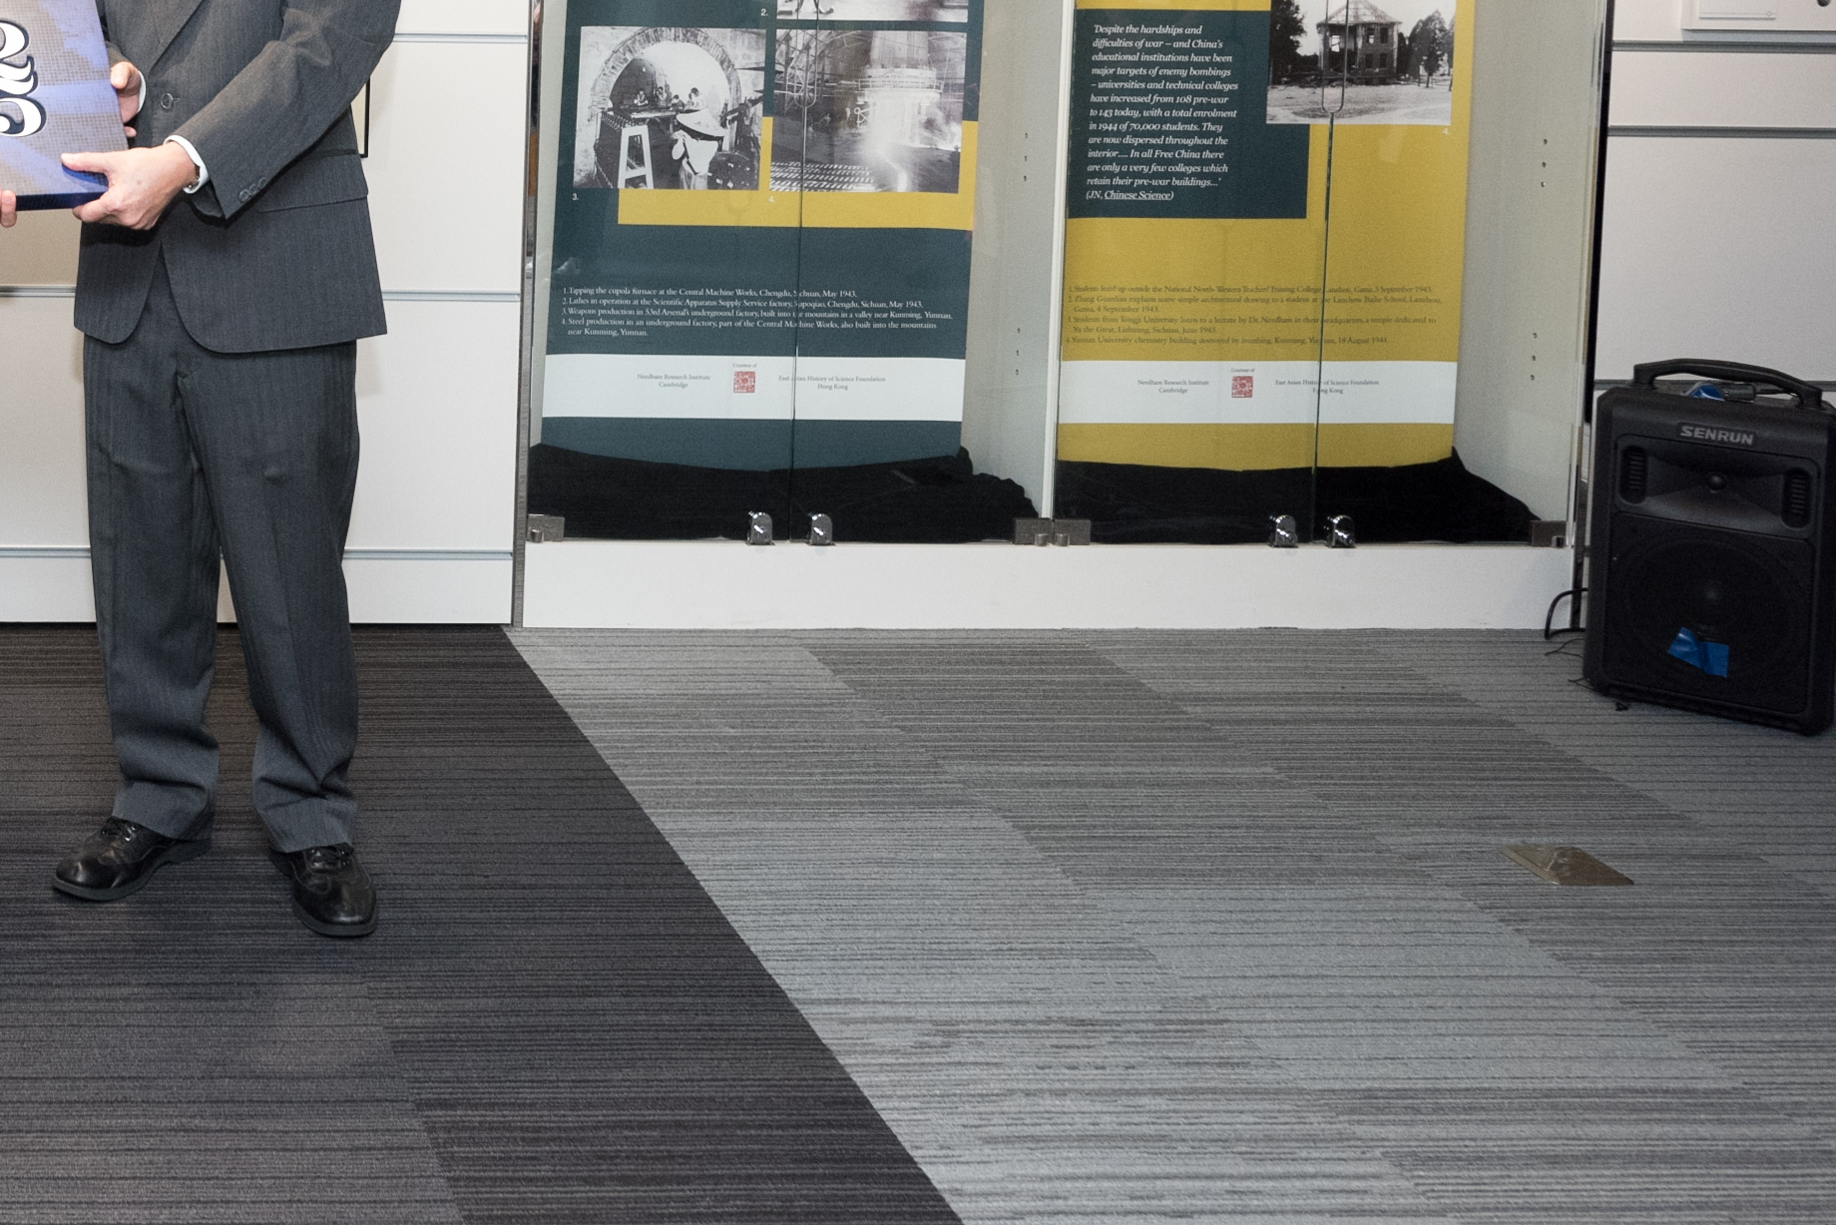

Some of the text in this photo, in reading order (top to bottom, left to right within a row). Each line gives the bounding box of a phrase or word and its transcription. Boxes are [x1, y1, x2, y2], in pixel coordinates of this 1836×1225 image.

[1125, 25, 1139, 33] the
[1140, 25, 1183, 36] hardships
[1185, 26, 1203, 34] and
[1092, 52, 1232, 62] educational institutions have been
[1112, 176, 1133, 185] their
[1134, 179, 1171, 187] pre-war
[1680, 425, 1754, 446] SENRUN
